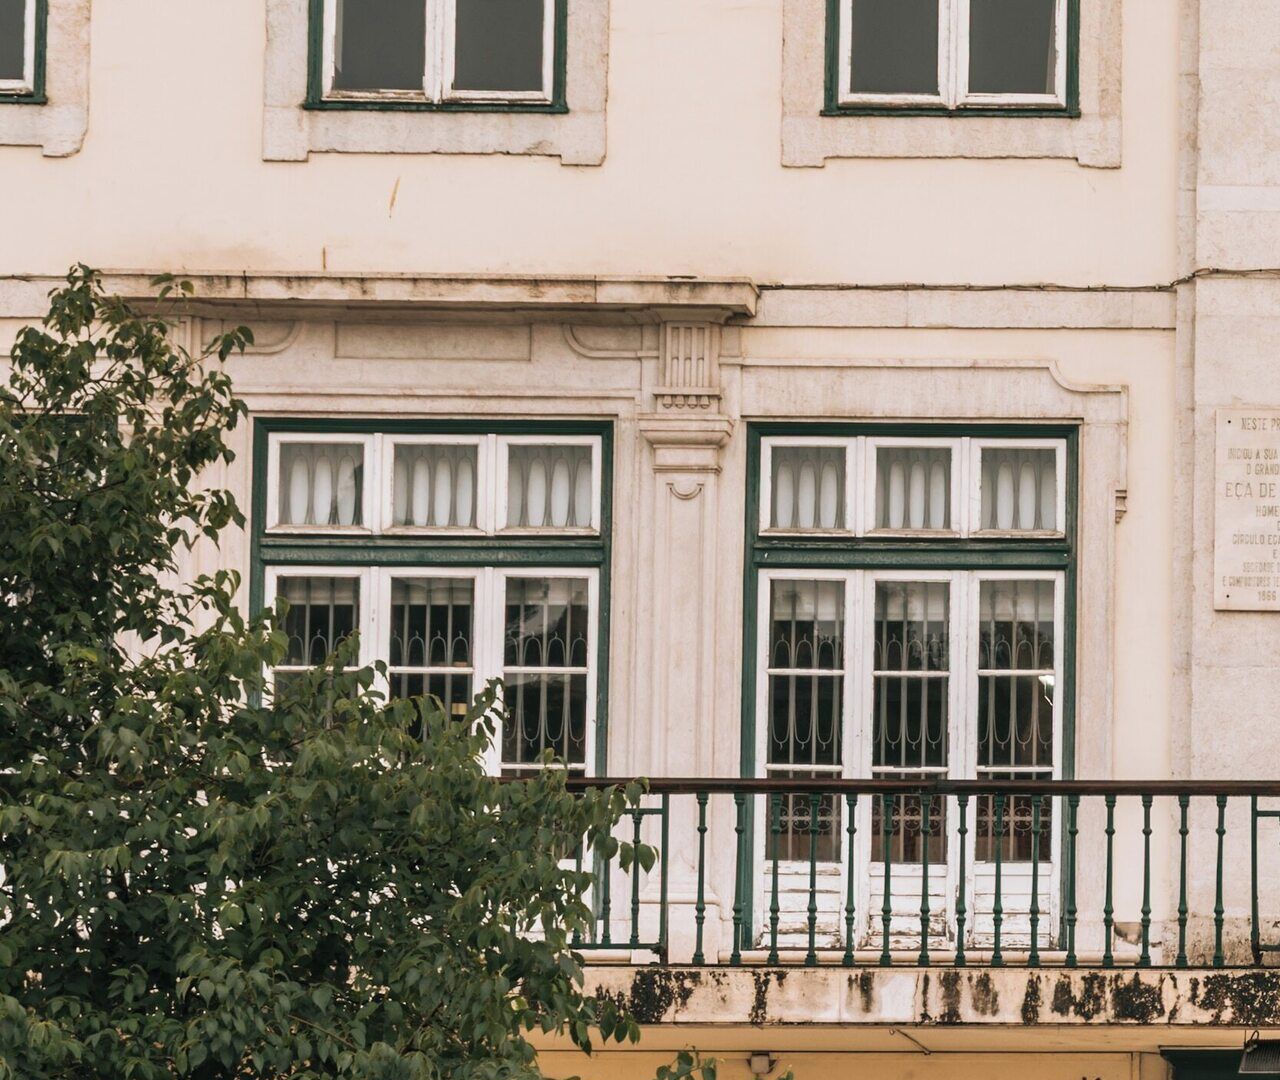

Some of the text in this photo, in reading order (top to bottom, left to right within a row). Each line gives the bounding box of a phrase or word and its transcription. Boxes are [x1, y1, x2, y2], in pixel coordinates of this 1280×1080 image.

[1241, 417, 1267, 431] NESTE
[1228, 448, 1252, 460] INICIOU
[1255, 448, 1260, 461] A
[1263, 448, 1278, 461] SUA
[1225, 482, 1253, 501] EÇA
[1259, 482, 1276, 498] DE
[1272, 548, 1278, 559] E
